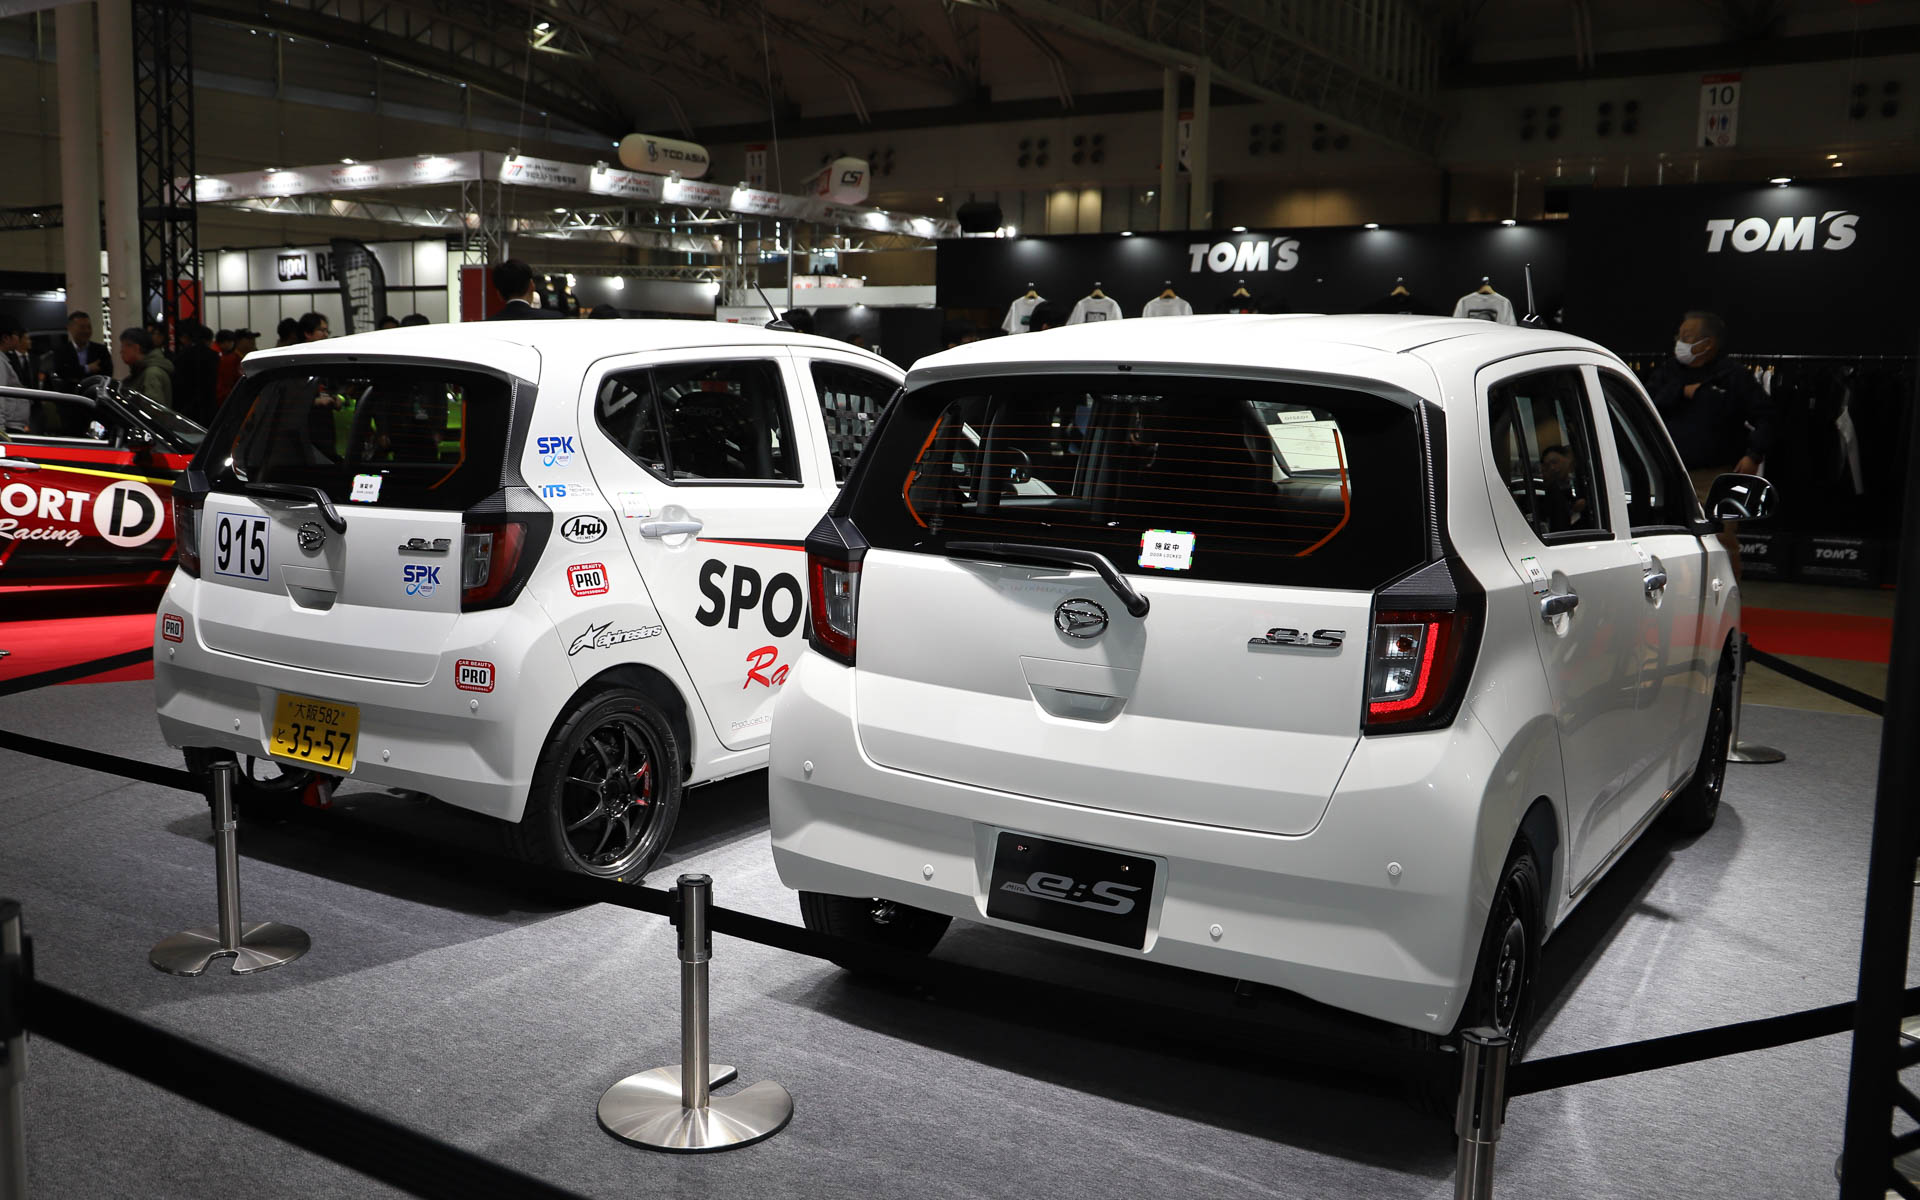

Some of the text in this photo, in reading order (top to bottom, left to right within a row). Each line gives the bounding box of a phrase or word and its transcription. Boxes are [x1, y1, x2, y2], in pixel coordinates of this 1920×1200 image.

[1709, 86, 1735, 105] 10
[1706, 211, 1860, 253] TOM'S
[1189, 237, 1300, 273] TOM'S
[537, 436, 575, 454] SPK
[0, 483, 90, 523] ORT
[0, 518, 83, 547] Racing
[564, 518, 602, 538] Arai
[217, 517, 266, 576] 915
[1815, 548, 1859, 560] TOM'S
[403, 564, 441, 585] SPK
[575, 571, 601, 588] PRO
[694, 558, 811, 641] SPO
[165, 620, 180, 636] PRO
[596, 624, 662, 649] alpinestars
[461, 668, 487, 685] PRO
[287, 722, 351, 765] 35-57
